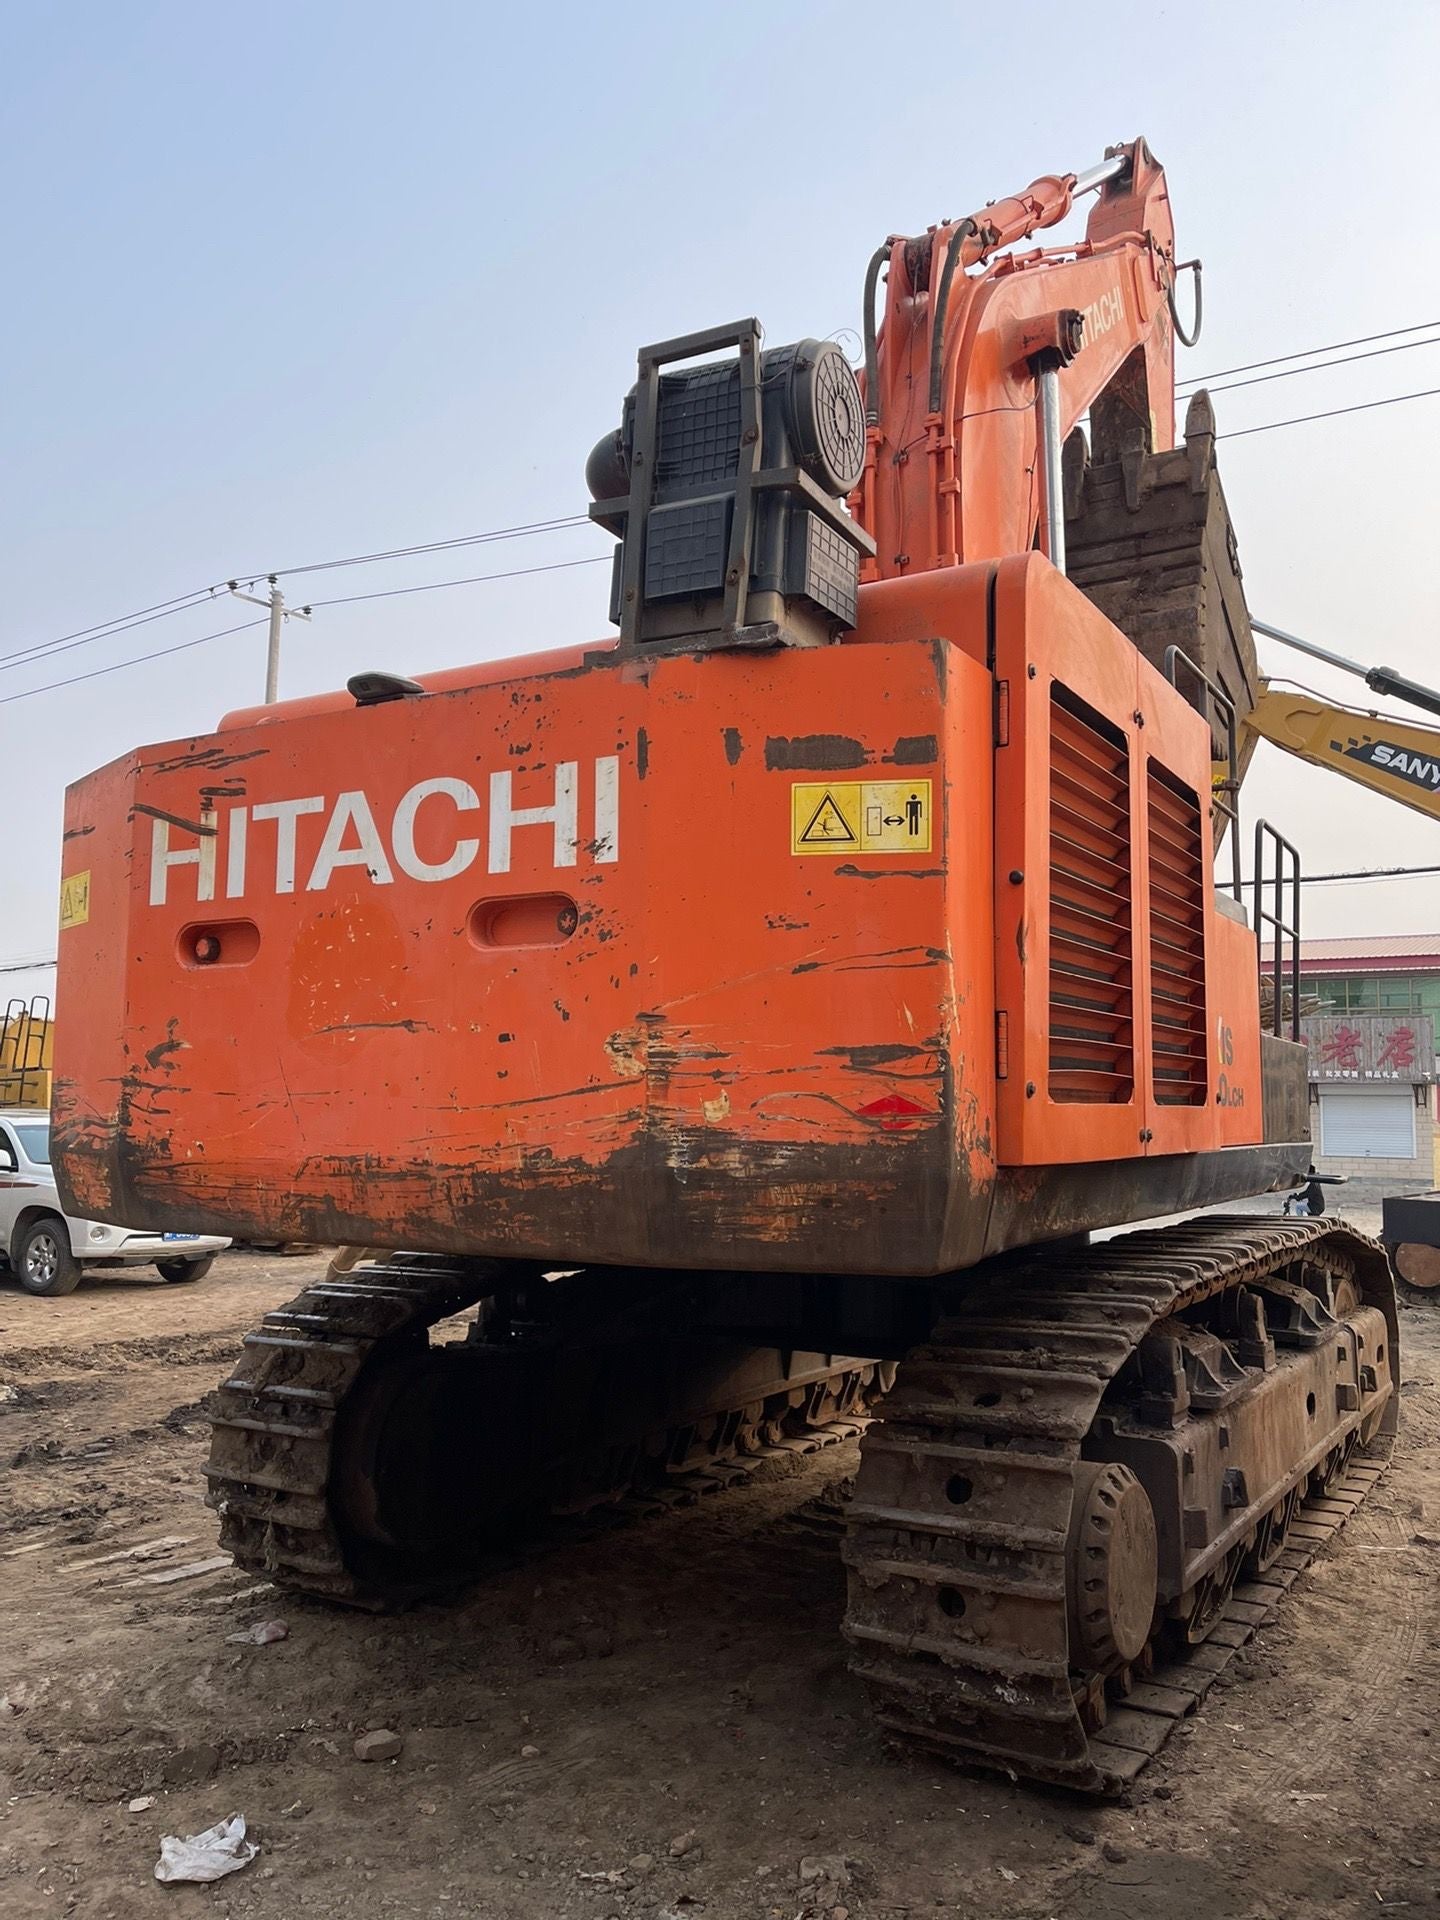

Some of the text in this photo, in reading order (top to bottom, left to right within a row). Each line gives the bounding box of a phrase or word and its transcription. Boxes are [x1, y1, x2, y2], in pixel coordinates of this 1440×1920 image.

[1080, 285, 1124, 350] ITACHI
[1370, 745, 1440, 784] SANY
[149, 755, 620, 906] HITACHI
[1287, 1025, 1415, 1070] 老店
